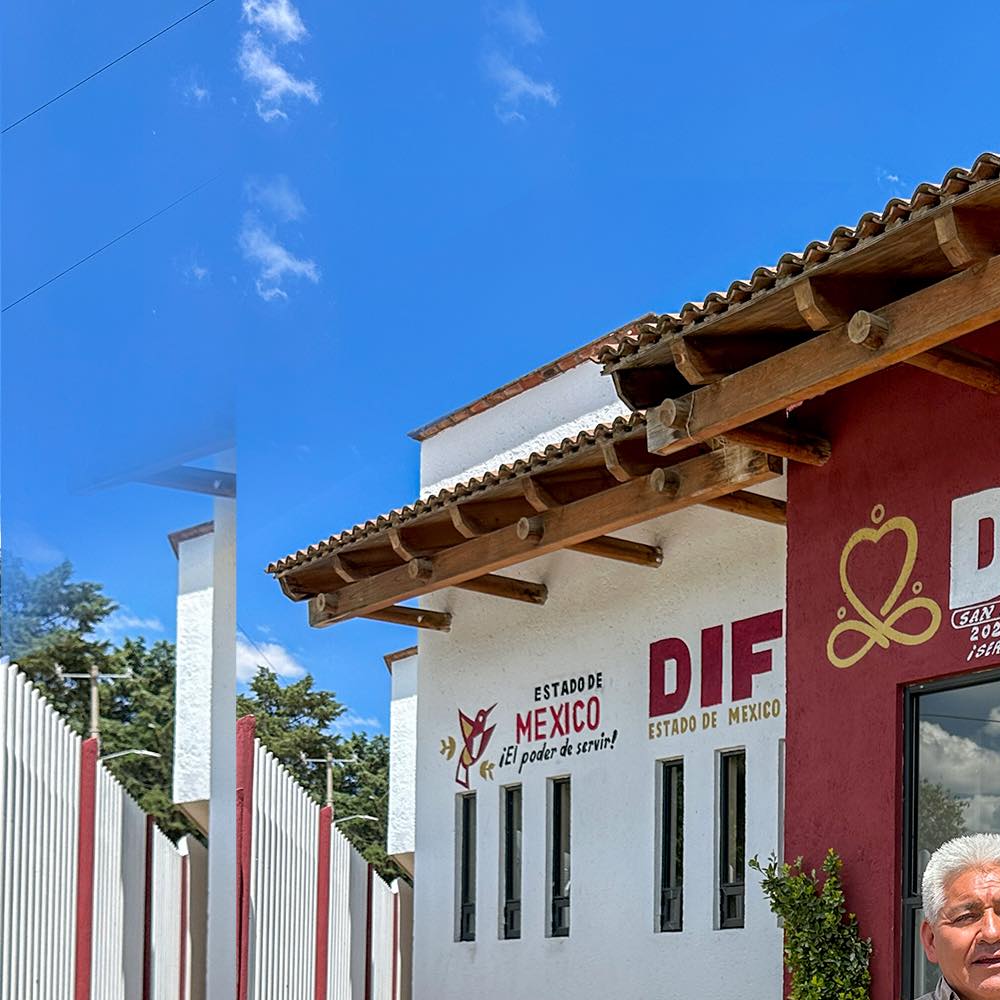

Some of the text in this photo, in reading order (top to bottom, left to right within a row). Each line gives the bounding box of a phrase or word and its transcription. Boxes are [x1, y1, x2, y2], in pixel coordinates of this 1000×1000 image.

[960, 604, 995, 626] SAN
[649, 609, 783, 718] DIF
[534, 672, 602, 702] ESTADO DE
[516, 695, 600, 744] MEXICO
[648, 698, 780, 739] ESTADO DE MEXICO
[499, 729, 618, 774] ¡El poder de servir!
